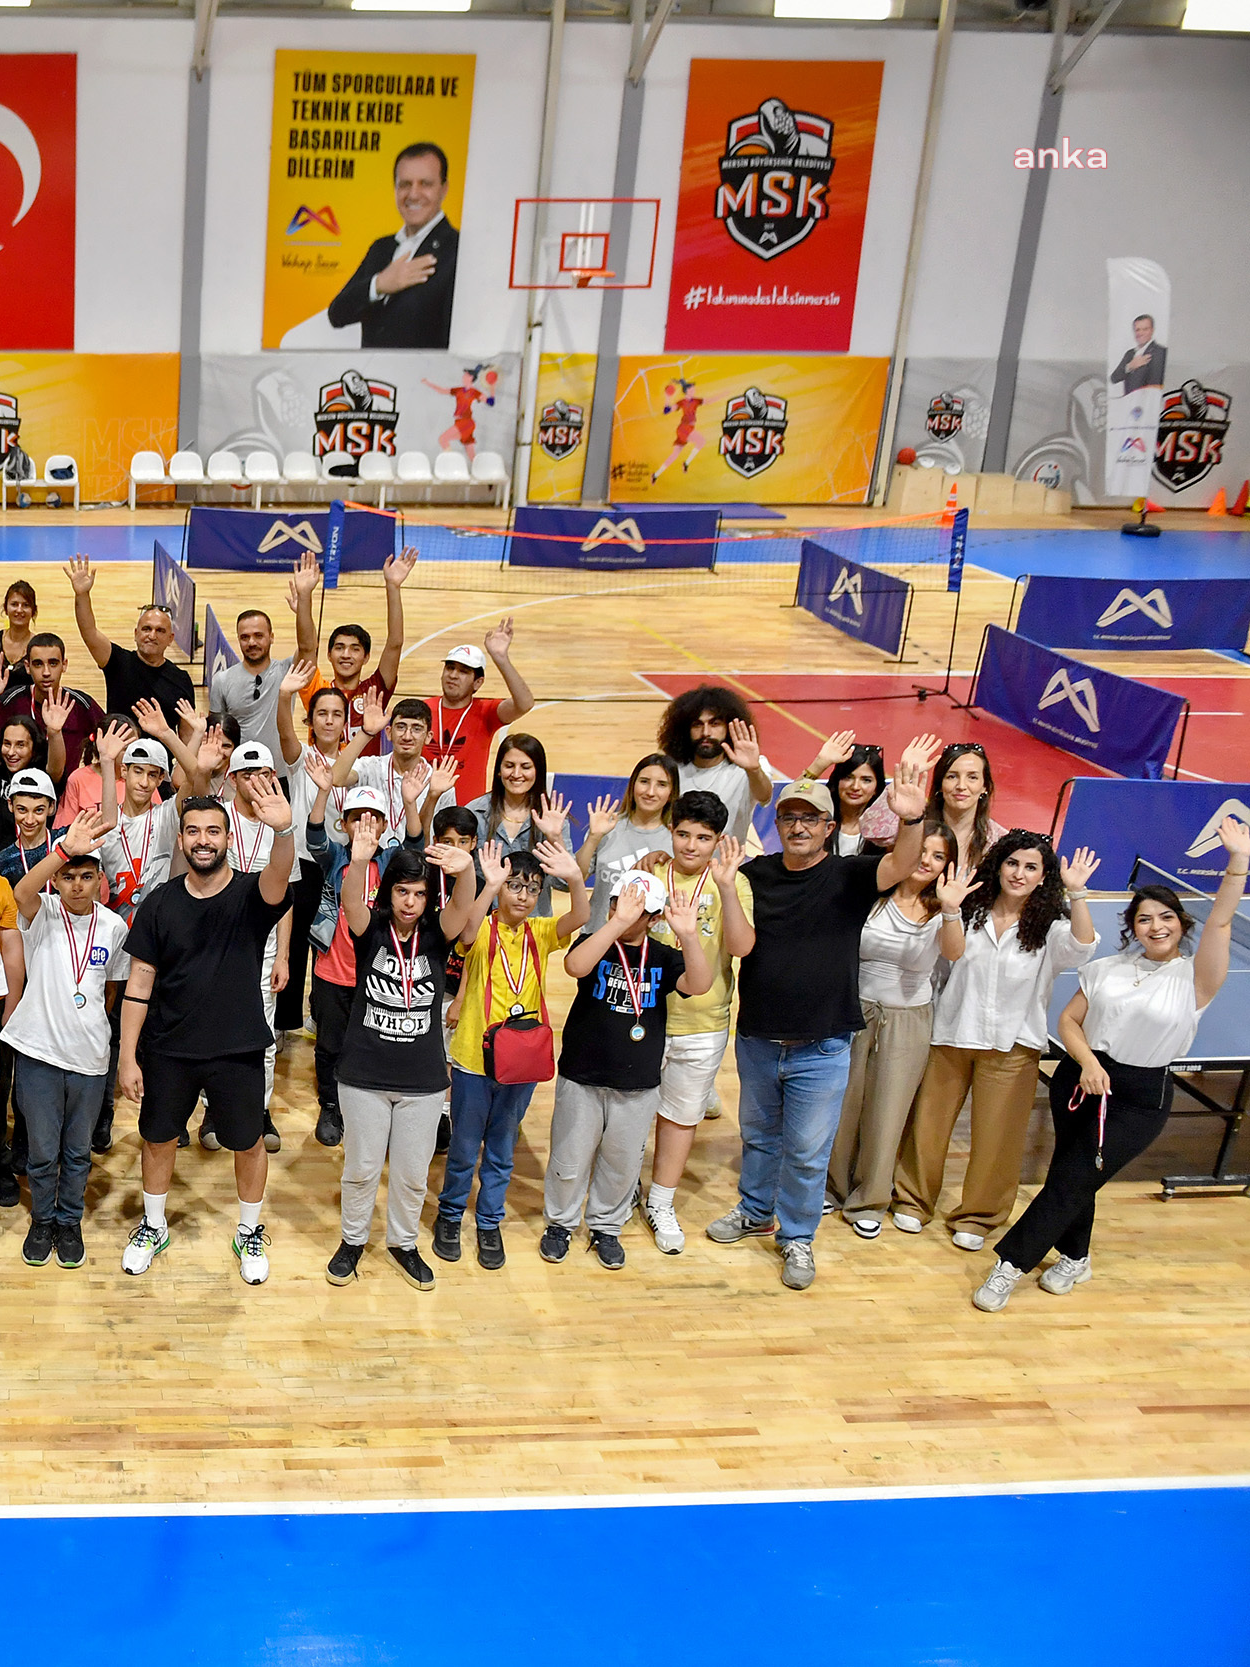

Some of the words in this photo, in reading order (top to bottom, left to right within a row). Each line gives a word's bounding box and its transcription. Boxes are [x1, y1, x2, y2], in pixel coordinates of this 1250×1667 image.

[293, 69, 327, 92] TÜM
[332, 73, 436, 96] SPORCULARA
[441, 76, 459, 97] VE
[291, 98, 351, 121] TEKNİK
[357, 101, 405, 124] EKİBE
[289, 128, 381, 152] BAŞARILAR
[287, 155, 354, 179] DİLERİM
[714, 171, 830, 219] MSK
[538, 426, 582, 445] MSK
[927, 414, 962, 432] MSK
[313, 421, 397, 457] MSK
[719, 427, 786, 455] MSK
[91, 948, 106, 961] efe
